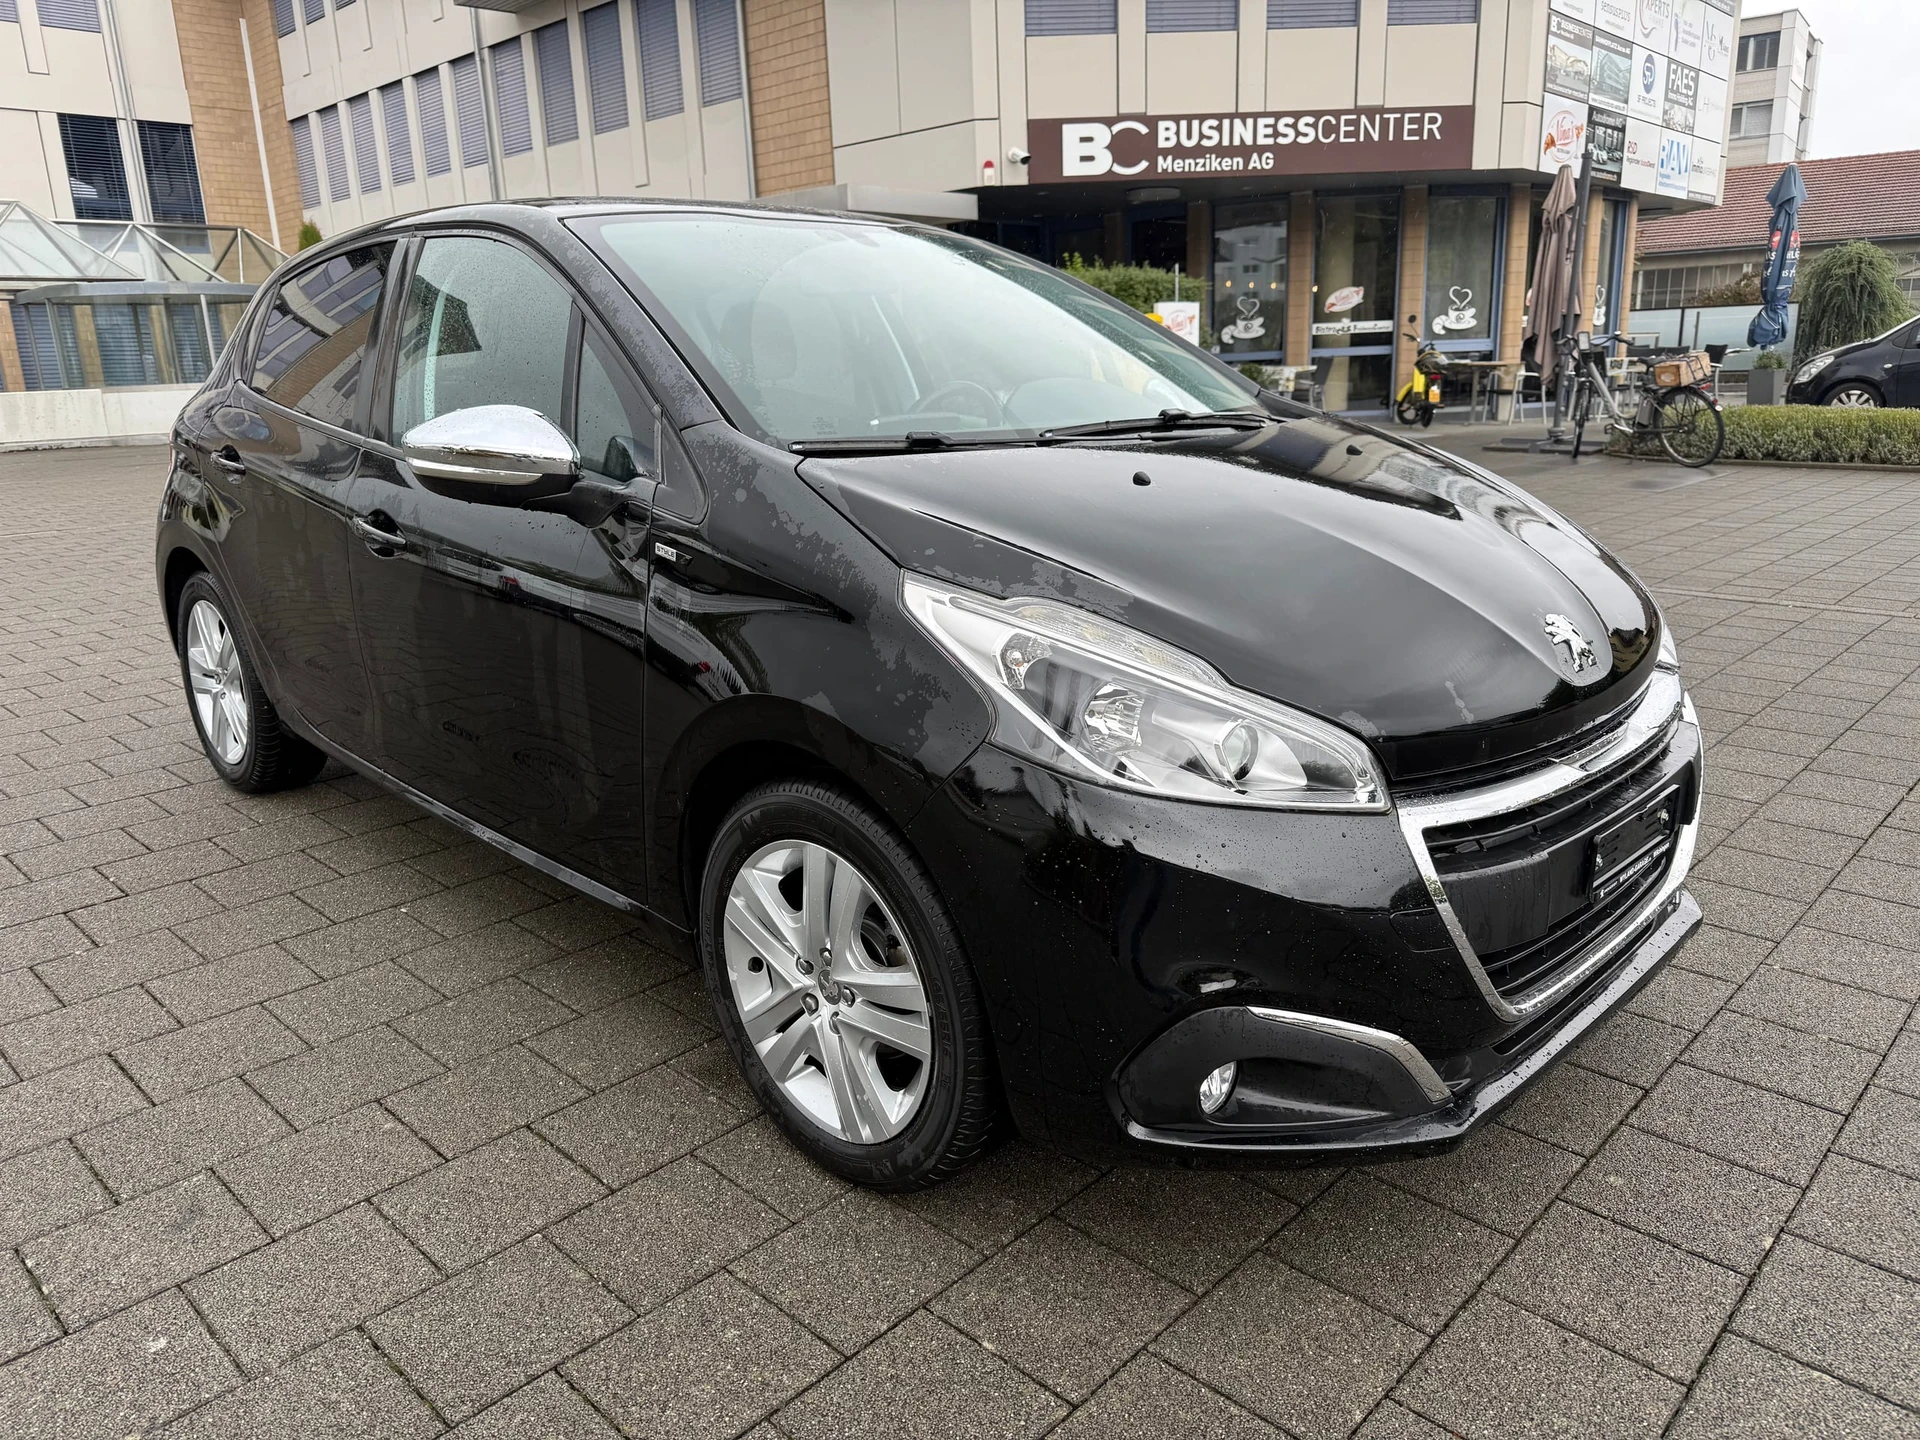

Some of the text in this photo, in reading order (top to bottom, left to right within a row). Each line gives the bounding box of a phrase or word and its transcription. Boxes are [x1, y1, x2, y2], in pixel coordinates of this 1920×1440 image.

[1669, 63, 1696, 97] FAES
[1157, 113, 1443, 148] BUSINESSCENTER
[1062, 120, 1150, 177] BC
[1157, 152, 1275, 174] Menziken AG
[657, 545, 675, 559] STYLE
